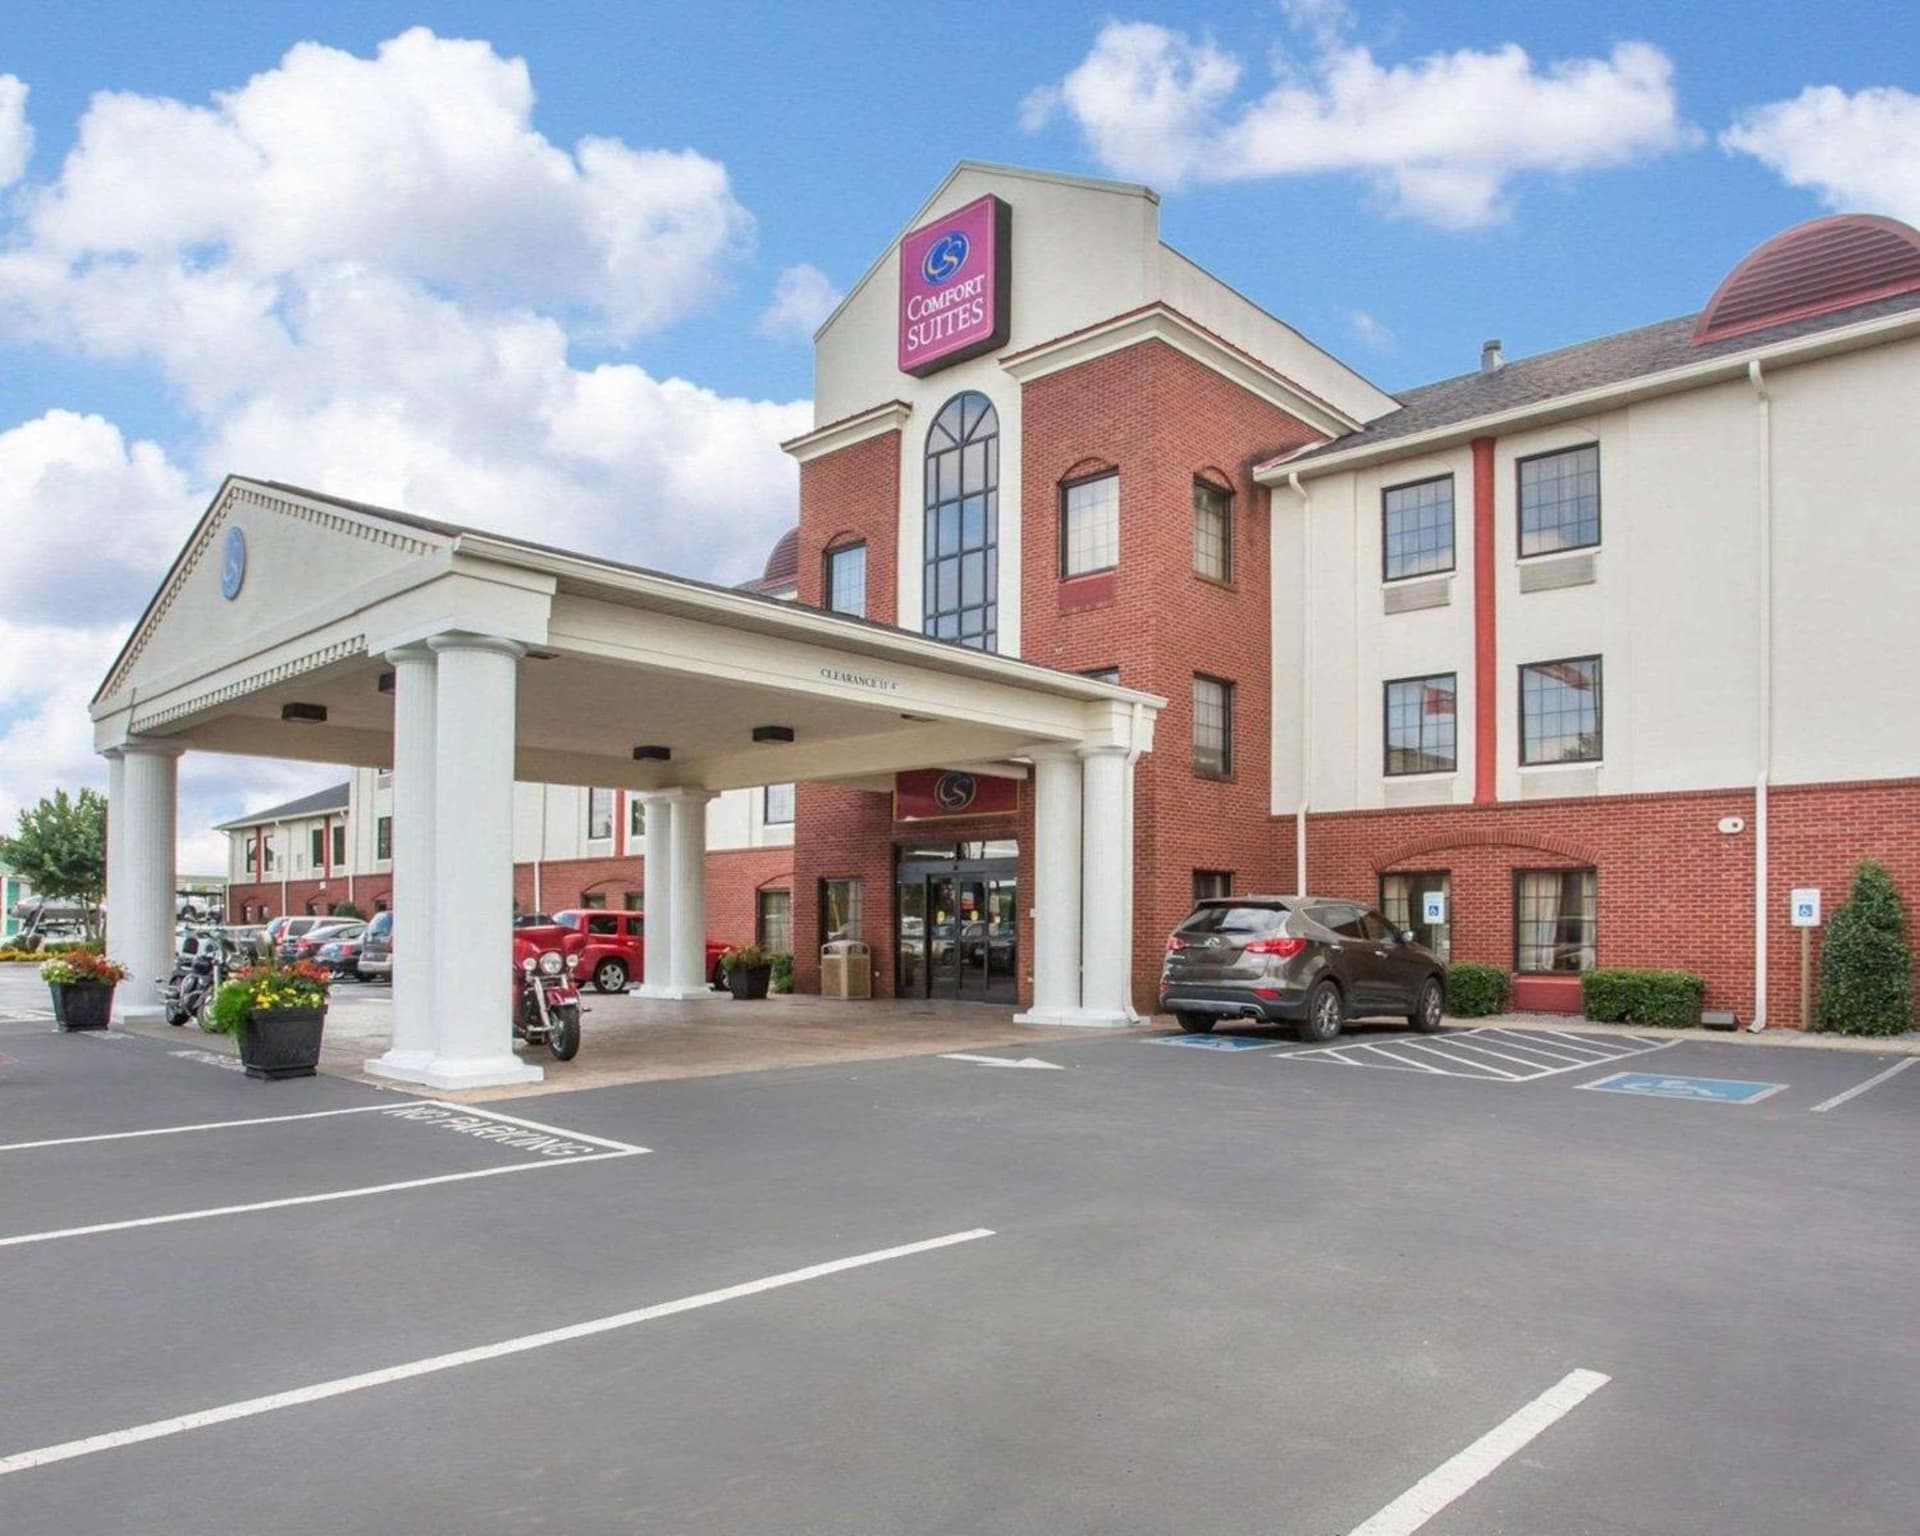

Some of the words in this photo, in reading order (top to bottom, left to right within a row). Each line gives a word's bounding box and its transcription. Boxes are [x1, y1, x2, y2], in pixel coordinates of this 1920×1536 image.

[907, 274, 985, 321] COMFORT
[907, 298, 984, 351] SUITES
[820, 668, 876, 688] CLEARANCE
[425, 1116, 594, 1155] PARKING
